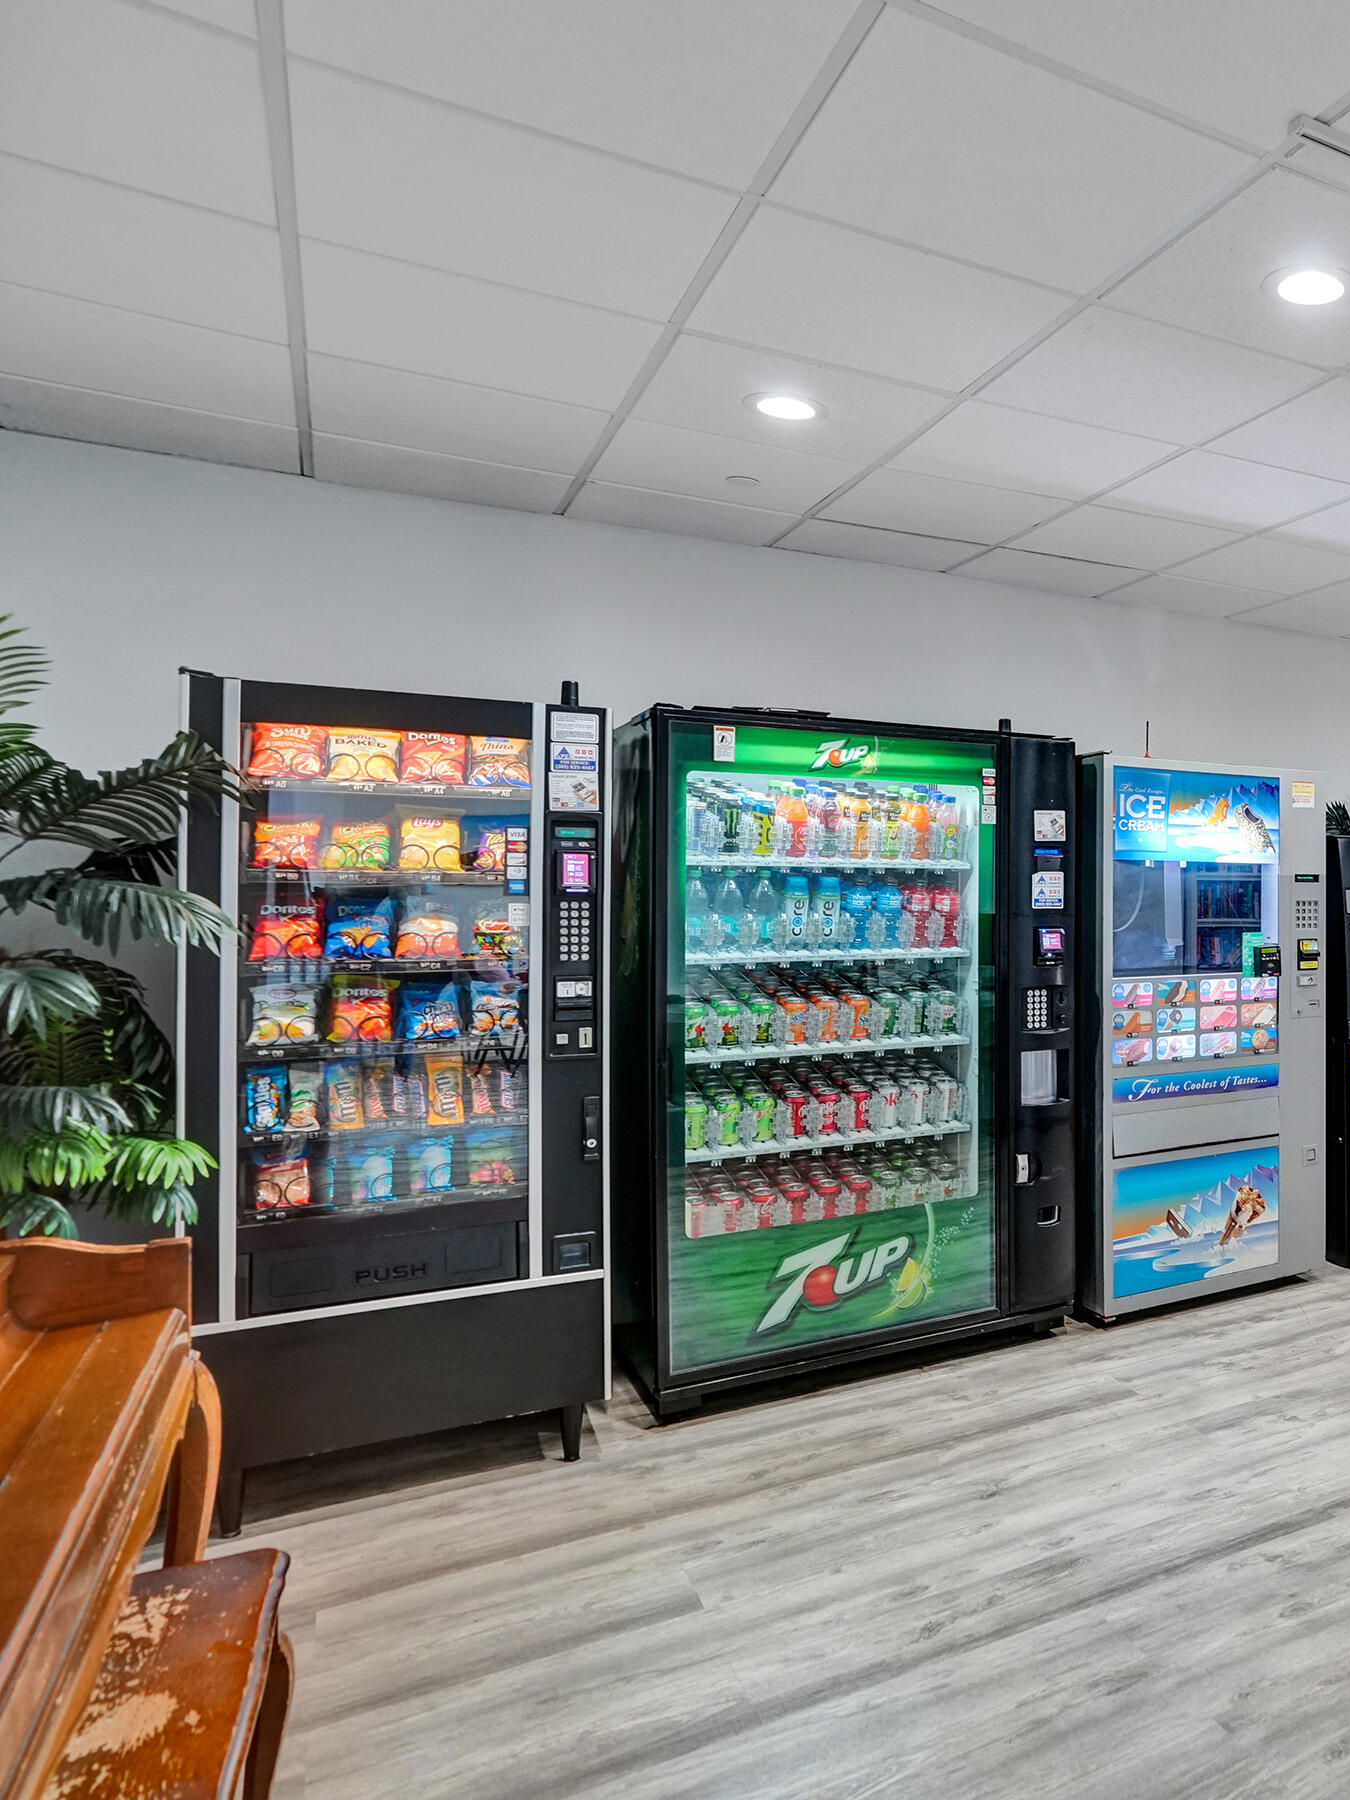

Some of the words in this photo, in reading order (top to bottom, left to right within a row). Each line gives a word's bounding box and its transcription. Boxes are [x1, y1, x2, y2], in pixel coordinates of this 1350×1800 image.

[335, 738, 387, 749] BAKED
[407, 731, 456, 746] Doritos
[811, 739, 869, 770] 7UP
[1119, 793, 1167, 819] ICE
[509, 830, 526, 838] VISA
[1118, 818, 1165, 832] CREAM
[260, 904, 316, 916] Doritos
[791, 899, 805, 937] core
[822, 899, 835, 937] core
[332, 986, 387, 998] Doritos
[1128, 1078, 1161, 1101] For
[1164, 1082, 1180, 1093] the
[1183, 1079, 1217, 1091] Coolest
[1219, 1076, 1232, 1090] of
[1232, 1075, 1267, 1086] Tastes...
[355, 1262, 428, 1285] PUSH
[756, 1232, 910, 1334] 7UP
